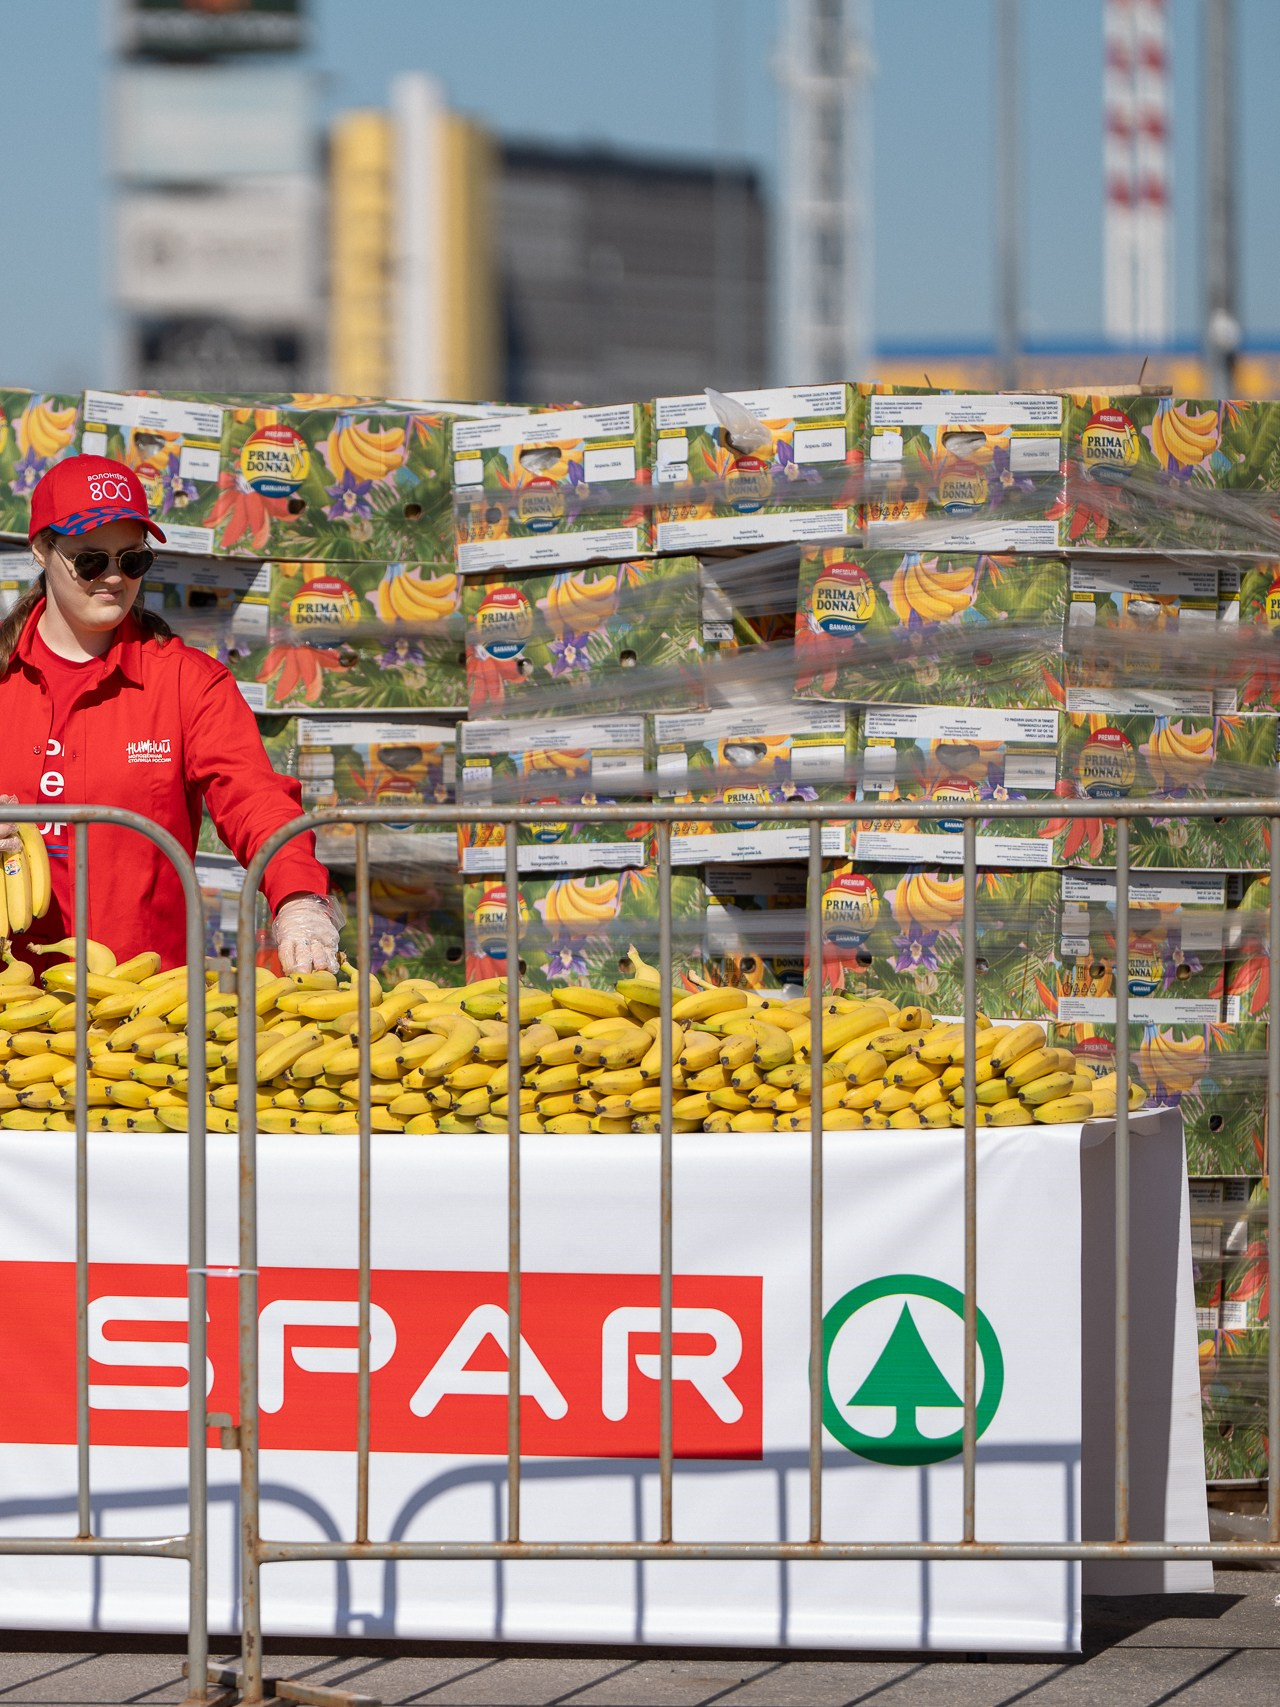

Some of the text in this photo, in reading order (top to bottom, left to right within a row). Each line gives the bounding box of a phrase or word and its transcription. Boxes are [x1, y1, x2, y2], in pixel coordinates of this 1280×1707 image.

[1087, 436, 1122, 448] PRIMA
[248, 450, 290, 462] PRIMA
[1086, 448, 1124, 459] DONNA
[246, 461, 292, 473] DONNA
[89, 480, 132, 502] 800
[942, 481, 973, 490] PRIMA
[941, 490, 975, 499] DONNA
[522, 505, 553, 515] DONNA
[831, 568, 858, 576] PREMIUM
[817, 589, 856, 600] PRIMA
[297, 602, 339, 613] PRIMA
[816, 600, 857, 612] DONNA
[296, 614, 340, 624] DONNA
[481, 612, 515, 623] PRIMA
[828, 623, 856, 631] BANANAS
[1084, 755, 1120, 766] PRIMA
[1083, 767, 1122, 778] DONNA
[727, 794, 755, 802] PRIMA
[825, 900, 861, 911] PRIMA
[825, 911, 861, 921] DONNA
[1128, 968, 1152, 977] ONNA
[87, 1294, 743, 1424] SPAR
